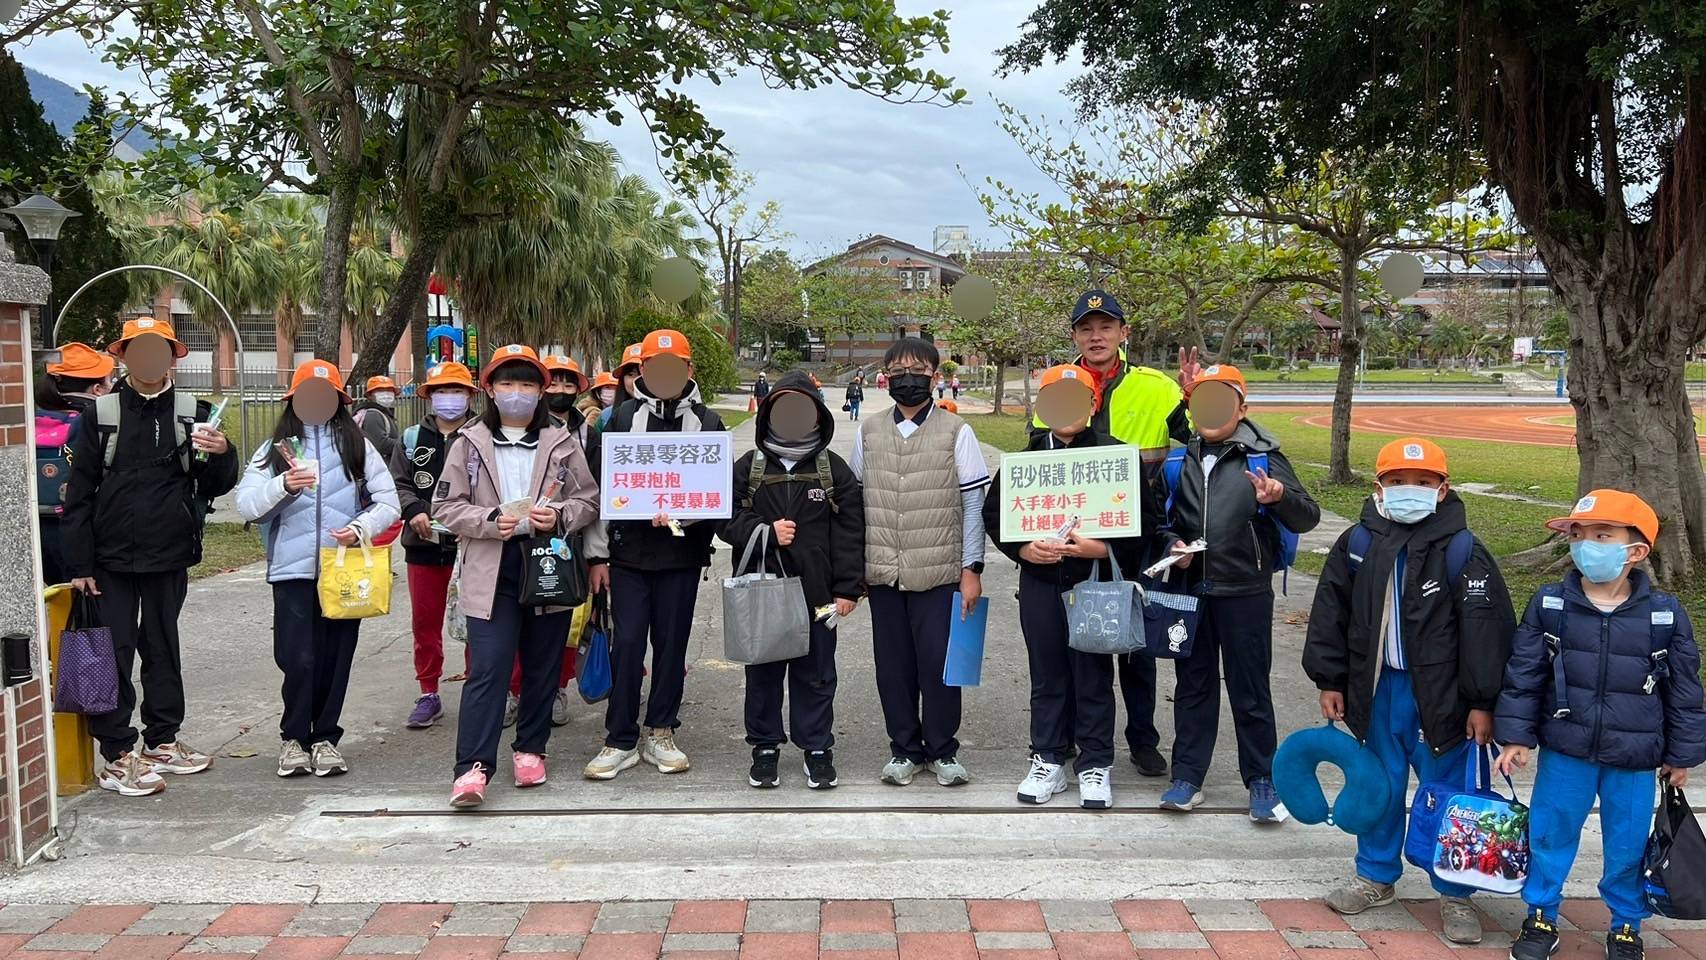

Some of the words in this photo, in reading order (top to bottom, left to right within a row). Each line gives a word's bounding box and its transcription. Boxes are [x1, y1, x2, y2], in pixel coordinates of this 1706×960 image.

[613, 444, 722, 465] 家暴零容忍
[612, 472, 681, 489] 只要抱抱
[1010, 462, 1066, 489] 兒少保護
[1071, 458, 1129, 485] 你我守護
[652, 492, 721, 510] 不要暴暴
[1011, 493, 1087, 512] 大手牽小手
[1021, 511, 1129, 531] 杜絕暴一起走
[531, 547, 555, 557] ROC
[1468, 580, 1485, 589] HH
[1534, 921, 1553, 932] FILA
[1615, 934, 1635, 943] FILA
